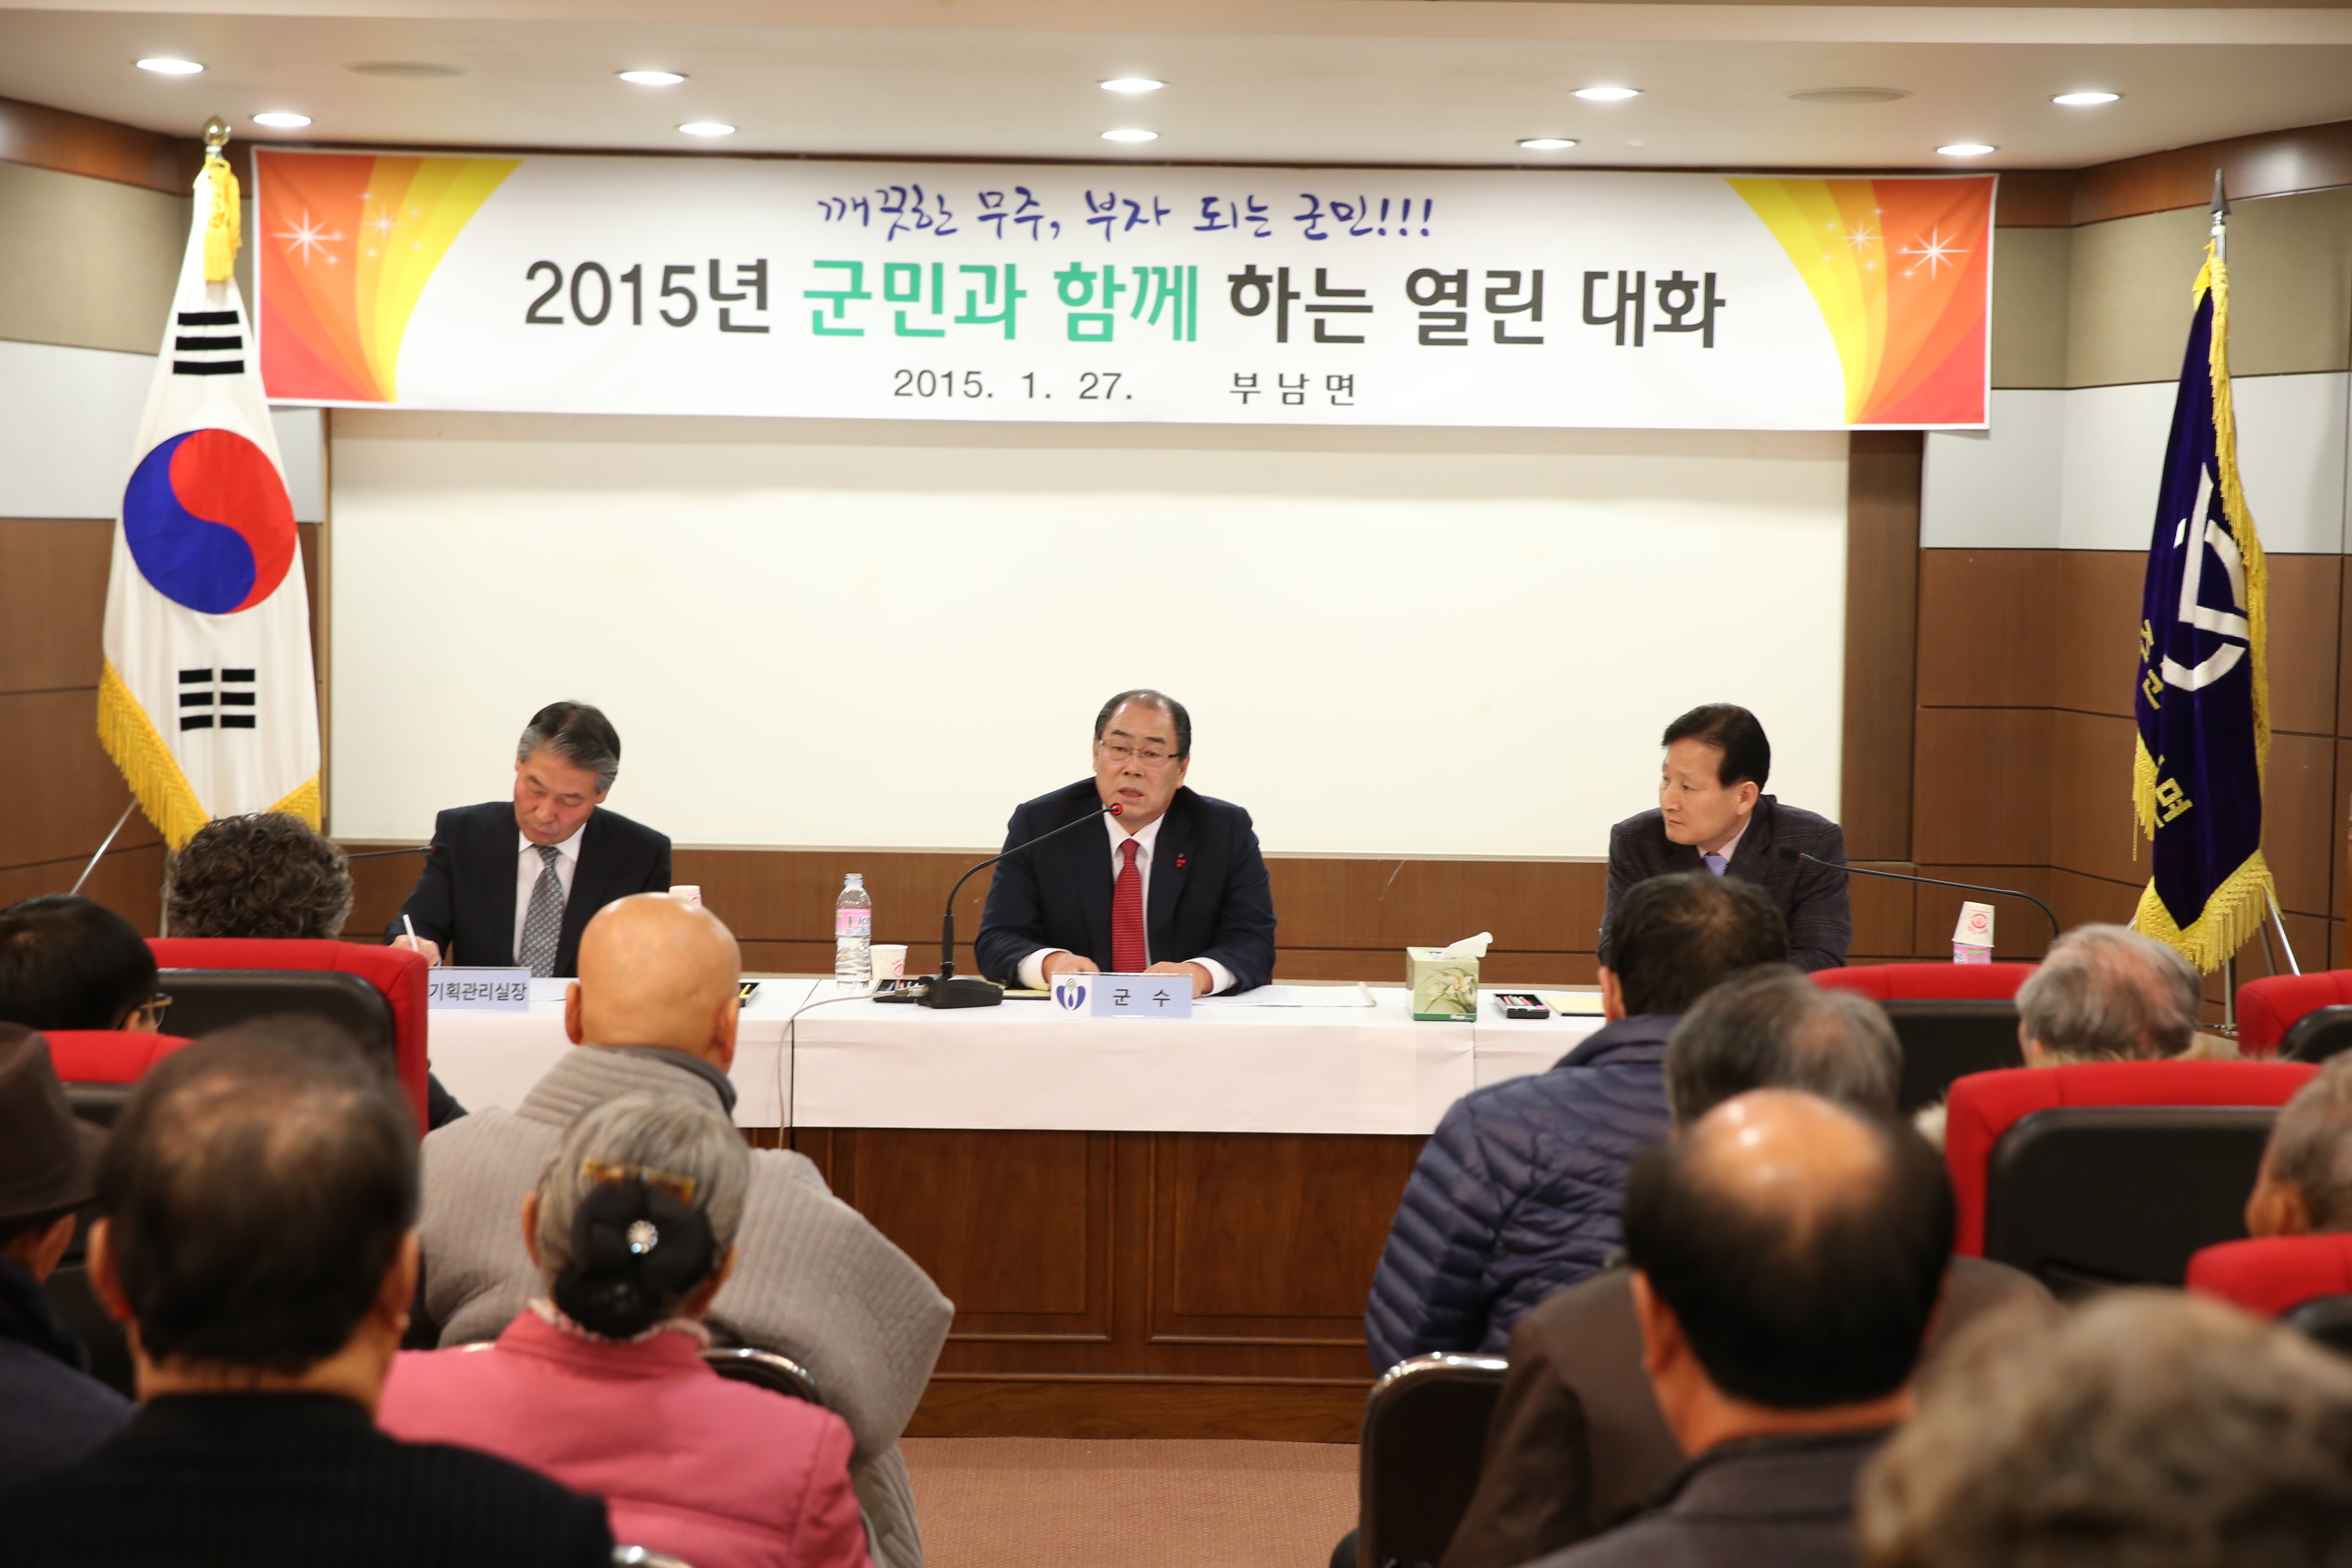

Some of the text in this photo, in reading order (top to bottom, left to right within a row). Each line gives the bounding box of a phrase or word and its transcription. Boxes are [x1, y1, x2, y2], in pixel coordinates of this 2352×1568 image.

[818, 184, 1433, 242] 깨끗한 무주, 부자 되는 군민!!!
[524, 258, 1727, 348] 2015년 군민과 함께 하는 열린 대화
[894, 369, 1132, 400] 2015. 1. 27.
[429, 982, 528, 1002] 기획관리실장
